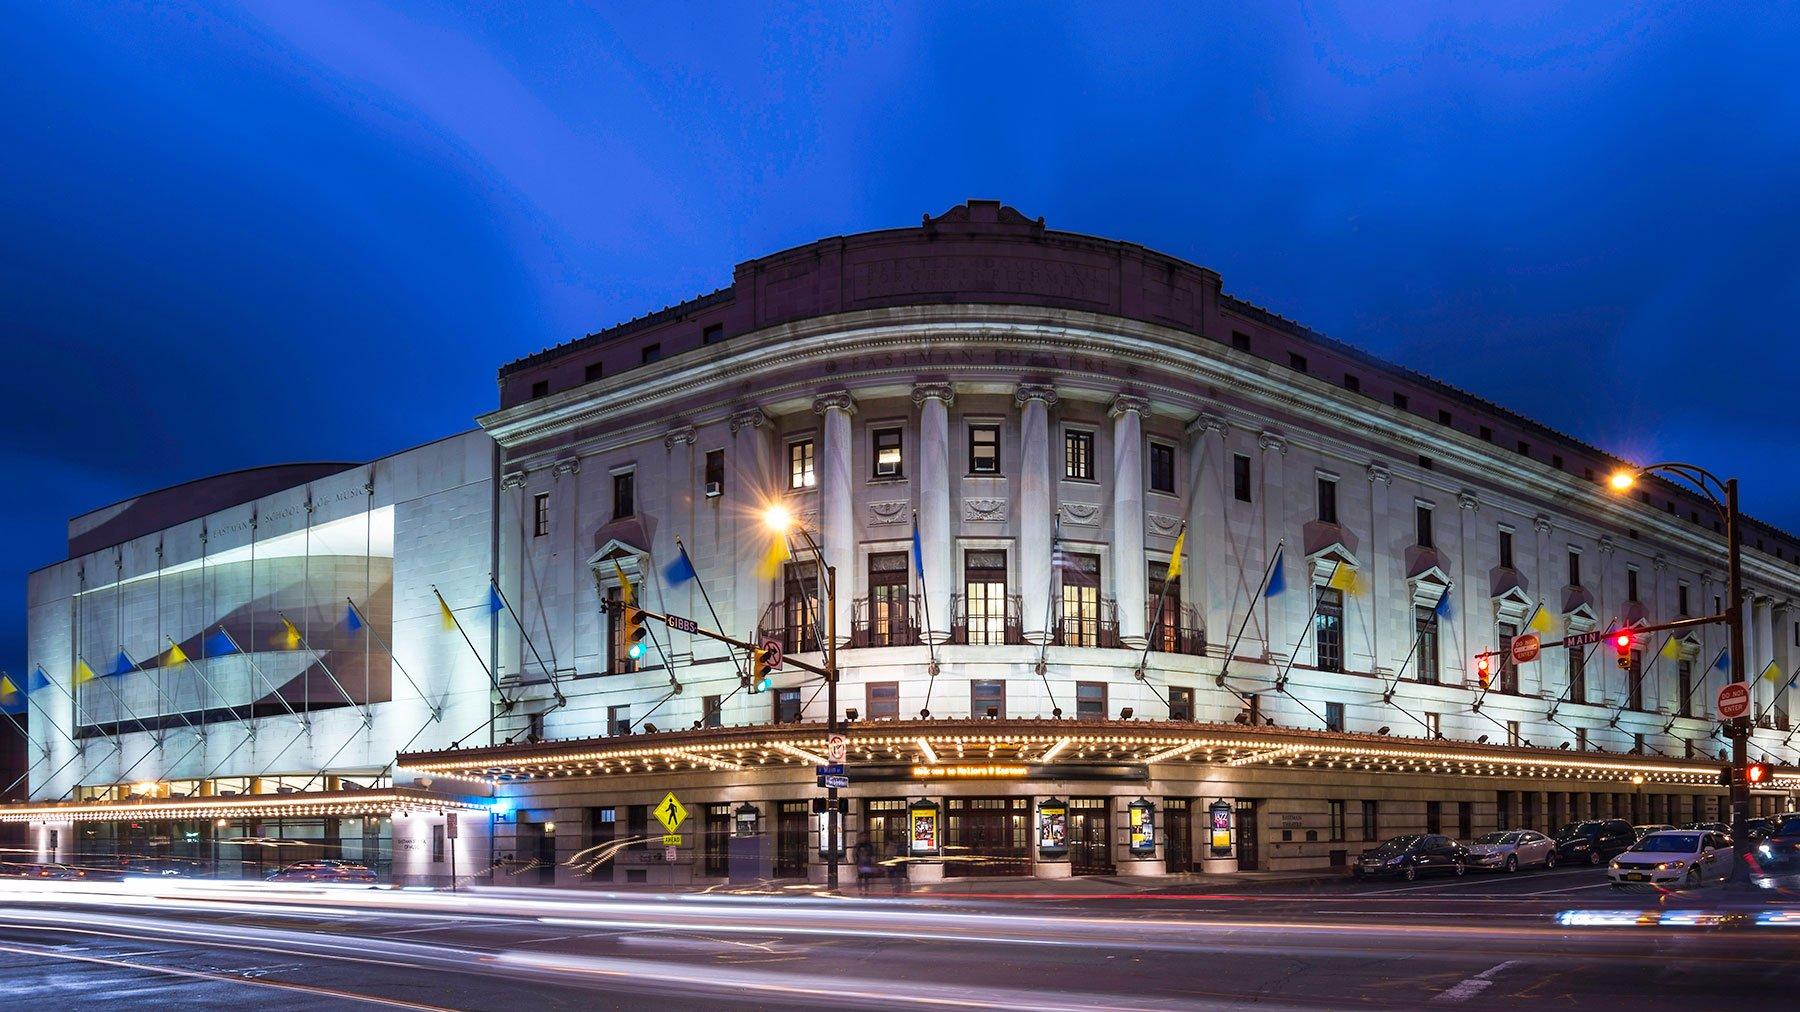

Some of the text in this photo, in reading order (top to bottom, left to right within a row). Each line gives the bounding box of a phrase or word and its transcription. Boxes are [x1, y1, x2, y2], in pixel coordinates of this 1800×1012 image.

[669, 616, 695, 632] GIBBS
[1567, 633, 1596, 646] MAIN
[1732, 689, 1745, 697] NOT
[1724, 704, 1744, 713] ENTER
